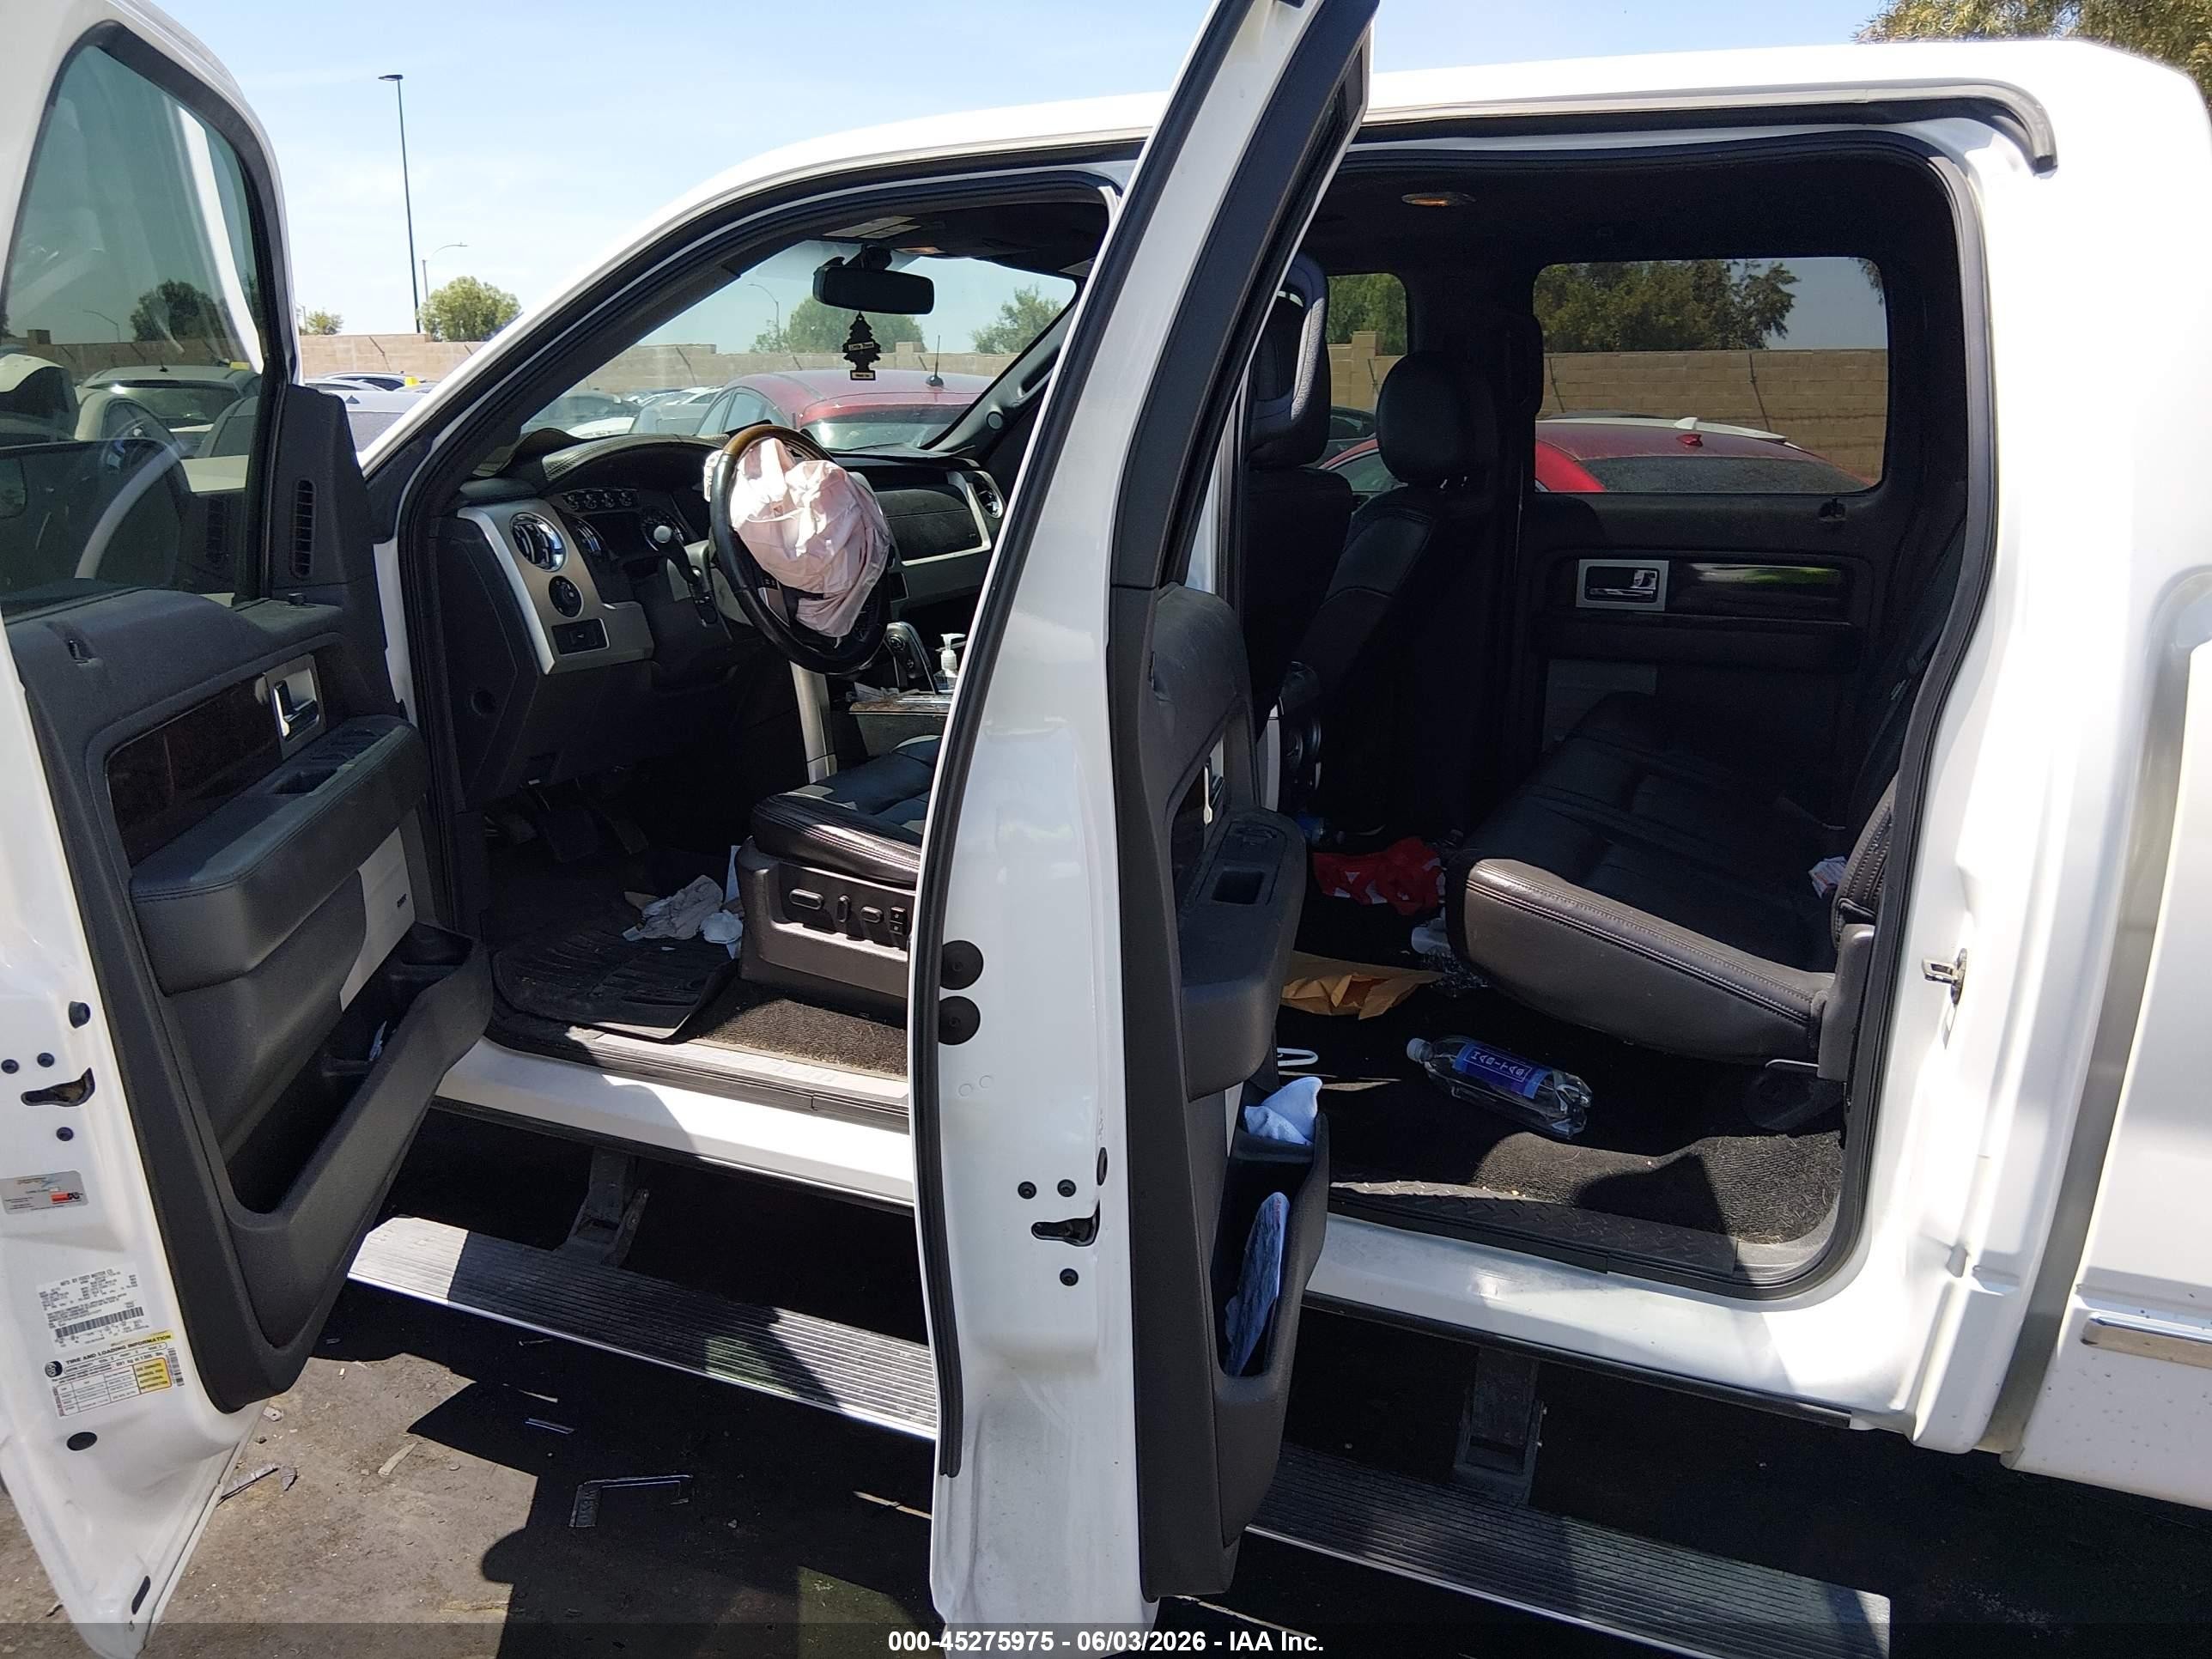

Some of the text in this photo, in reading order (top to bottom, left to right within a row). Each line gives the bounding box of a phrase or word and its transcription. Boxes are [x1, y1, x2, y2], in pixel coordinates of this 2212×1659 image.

[1470, 1051, 1525, 1077] HABITAS
[65, 1356, 82, 1365] TIRE
[82, 1352, 97, 1361] AND
[98, 1346, 127, 1356] LOADING
[128, 1334, 172, 1347] INFORMATION
